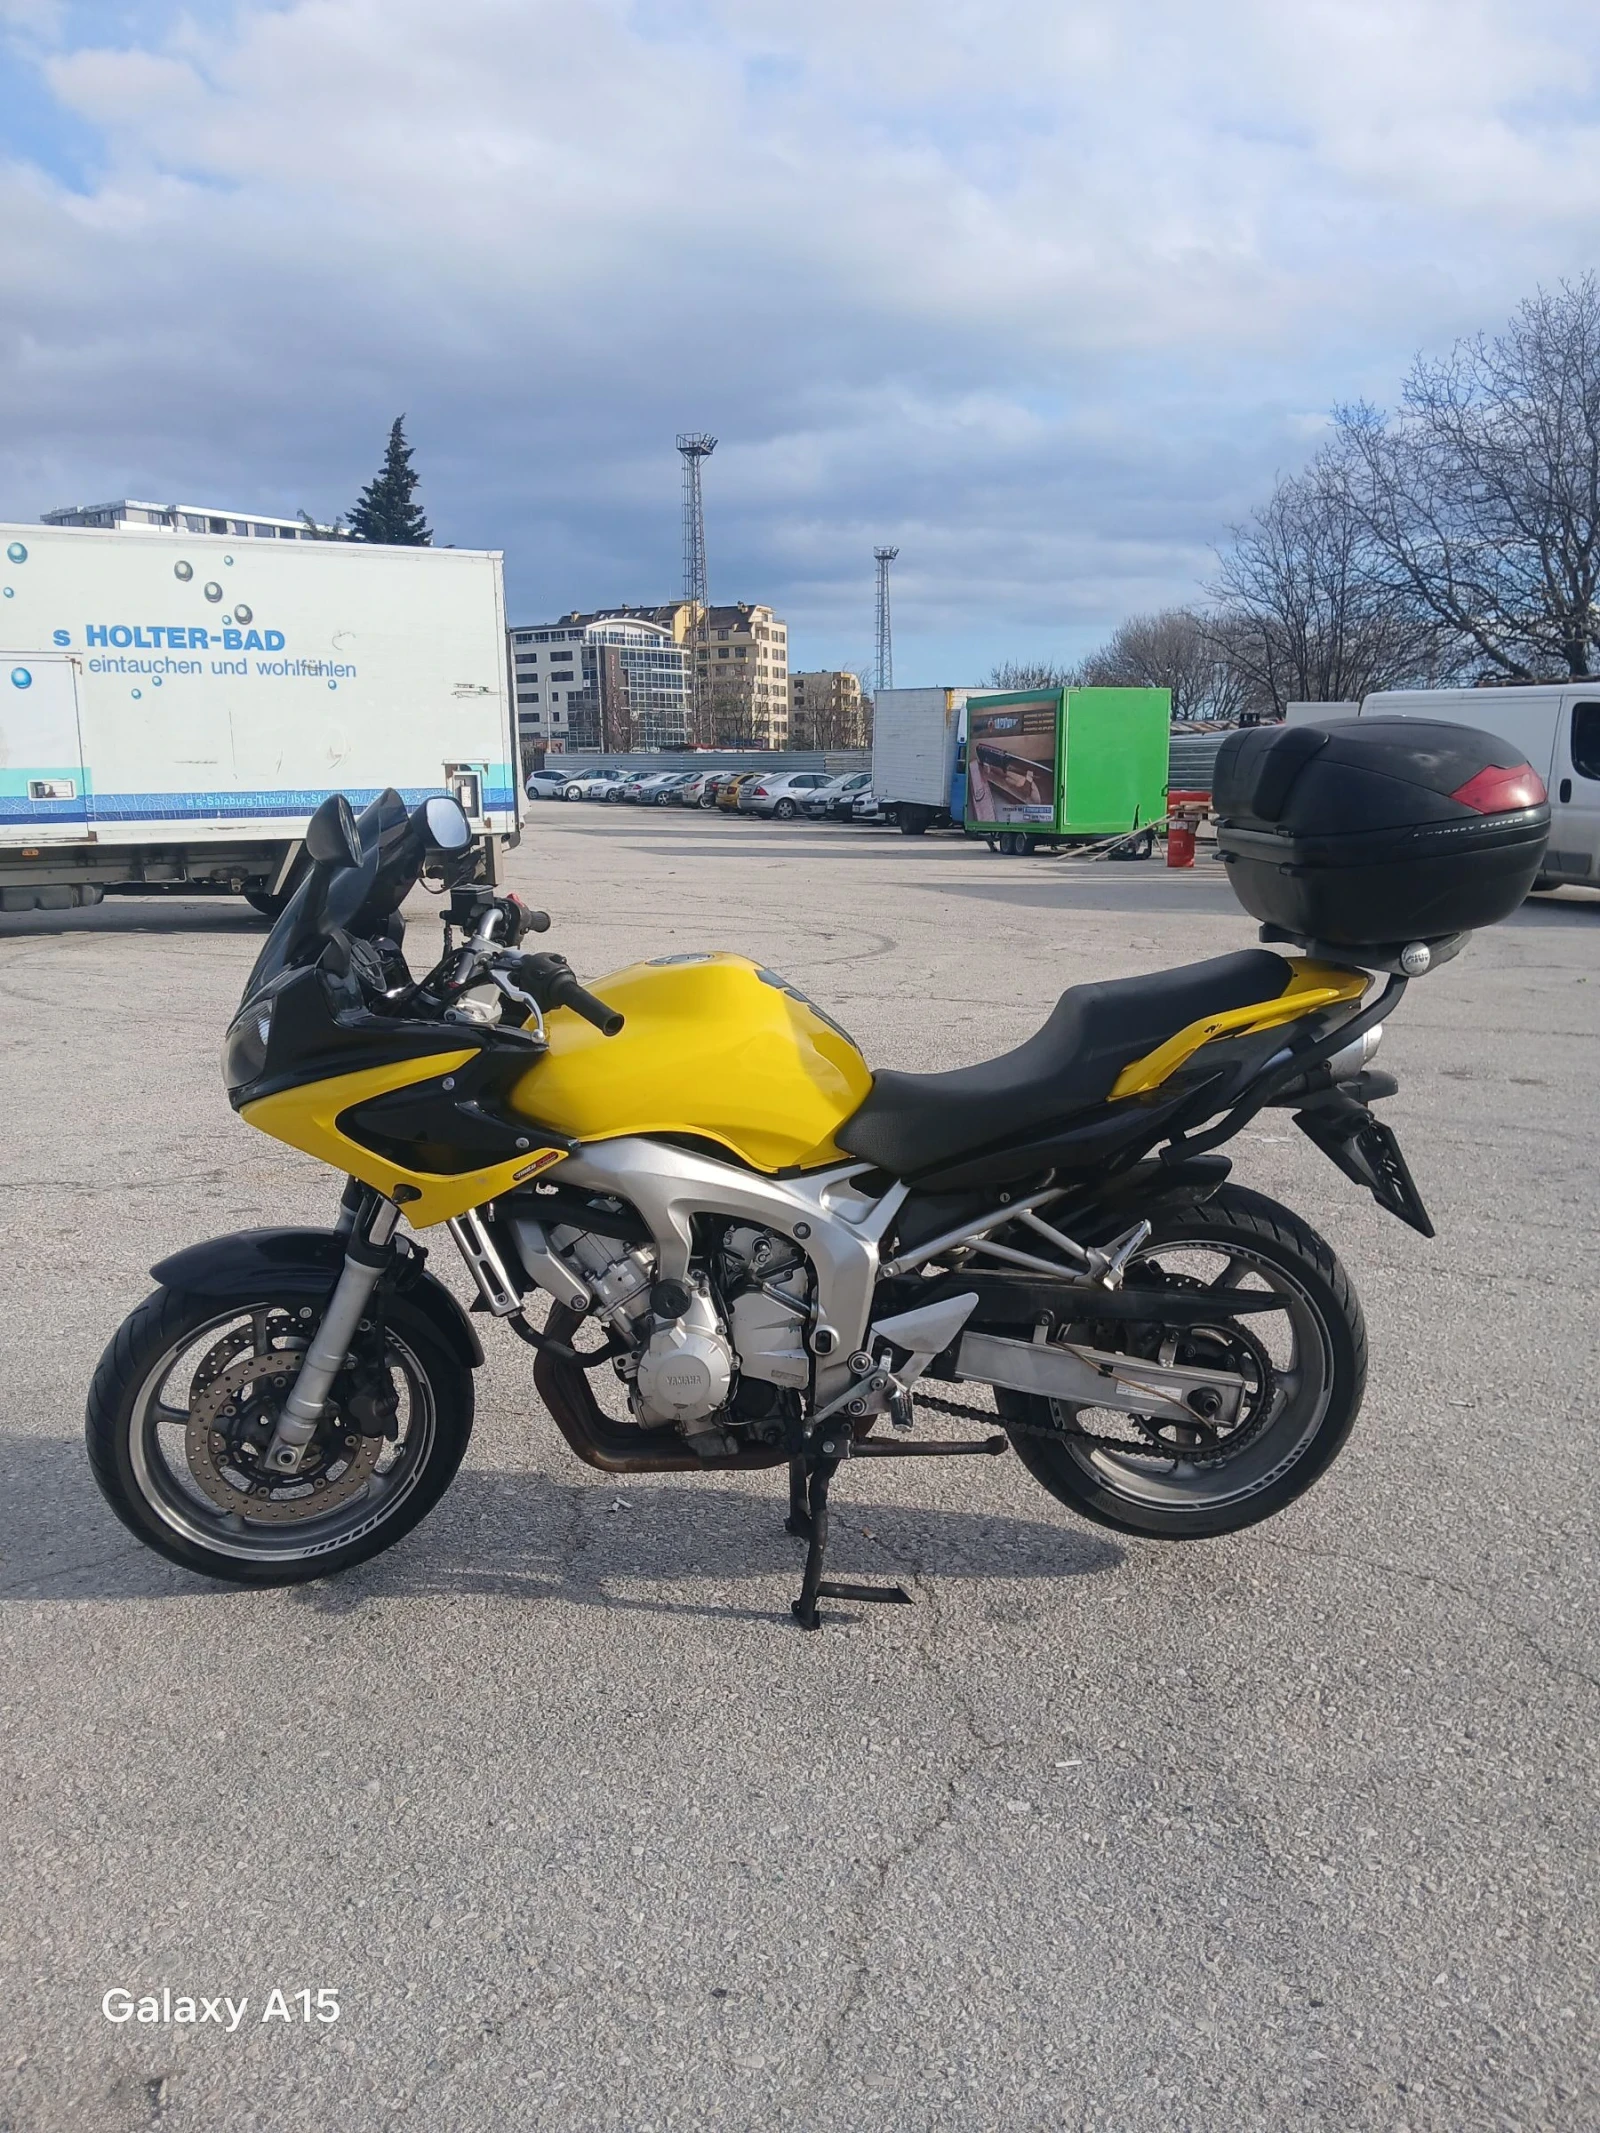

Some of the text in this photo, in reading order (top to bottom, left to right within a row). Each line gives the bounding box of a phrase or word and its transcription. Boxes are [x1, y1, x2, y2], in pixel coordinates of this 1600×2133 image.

[86, 624, 286, 651] HOLTER-BAD
[88, 655, 357, 678] eintauchen und wohlfühlen
[665, 1375, 702, 1386] YAMAHA
